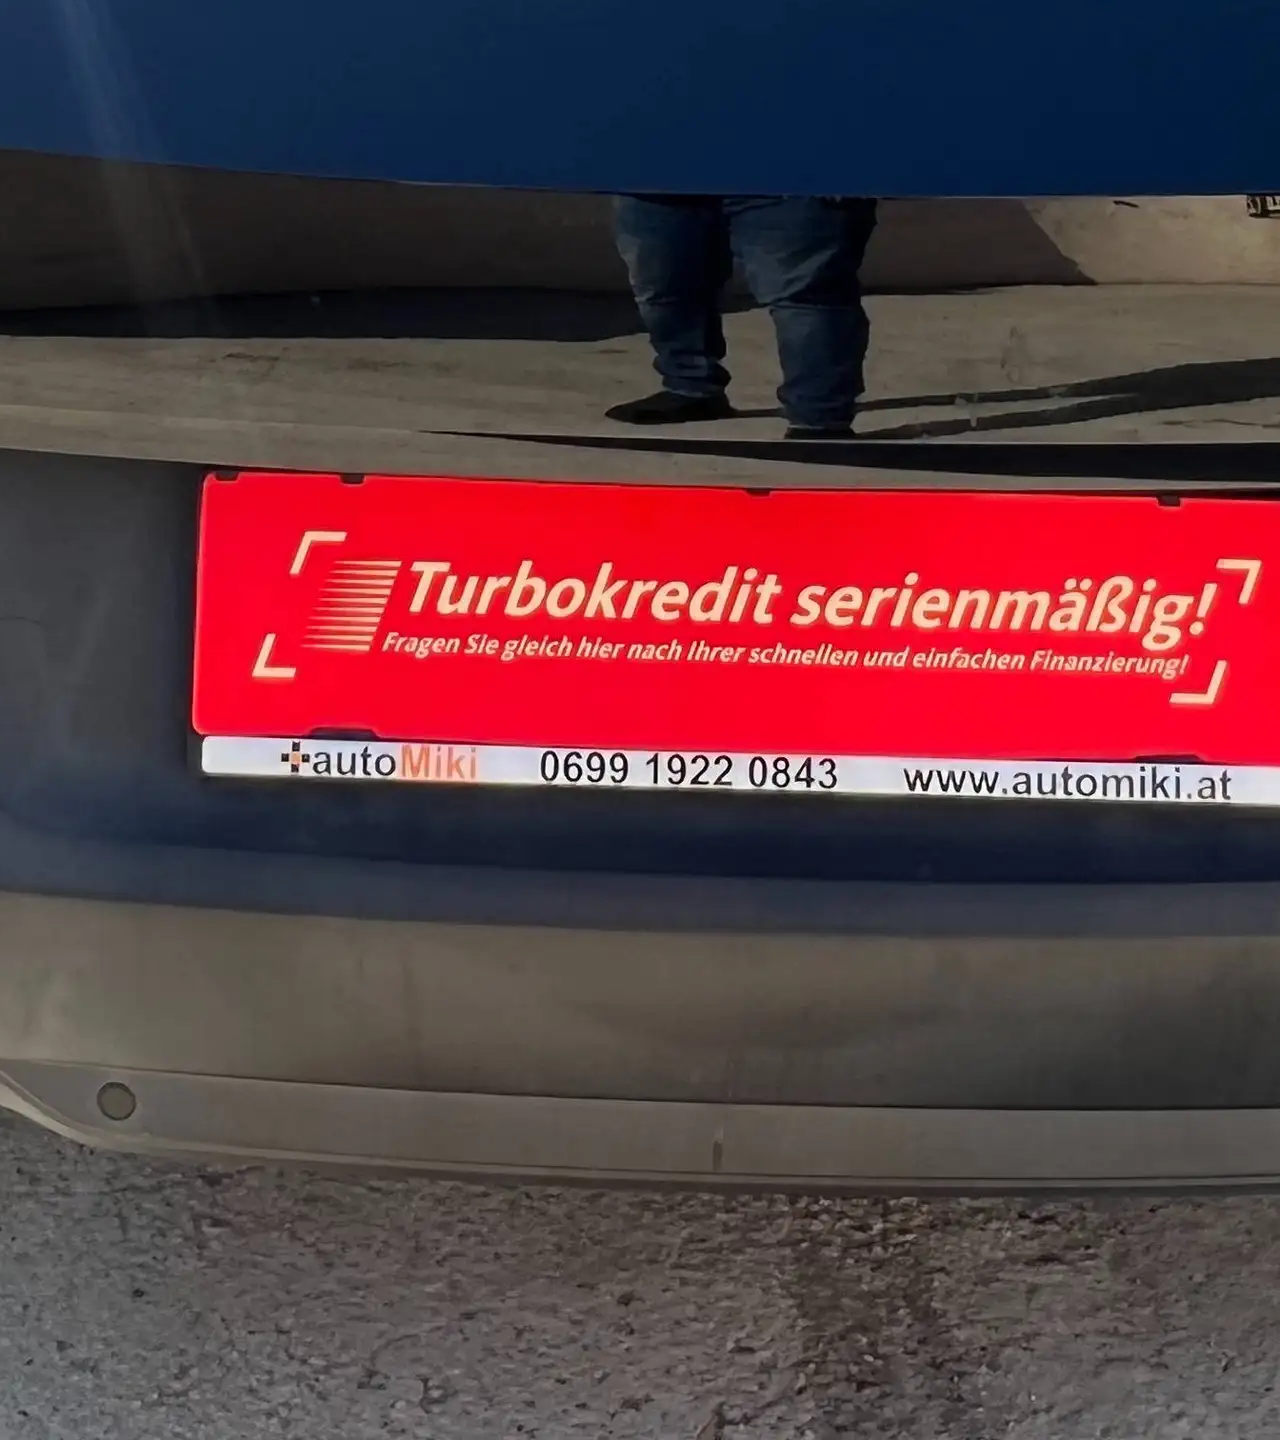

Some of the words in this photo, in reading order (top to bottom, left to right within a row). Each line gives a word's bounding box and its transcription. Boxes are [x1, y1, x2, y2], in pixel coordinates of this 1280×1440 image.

[410, 560, 782, 625] Turbokredit
[790, 572, 1218, 651] serienmäßig!
[381, 631, 459, 659] Fragen
[464, 633, 499, 656] Sie
[502, 634, 573, 662] gleich
[576, 636, 624, 659] hier
[627, 638, 683, 662] nach
[687, 640, 746, 664] Ihrer
[748, 642, 859, 666] schnellen
[863, 643, 910, 668] und
[912, 646, 1026, 671] einfachen
[1029, 650, 1191, 680] Finanzierung!
[540, 750, 629, 784] 0699
[646, 753, 733, 786] 1922
[748, 756, 839, 789] 0843
[903, 765, 1233, 801] www.automiki.at
